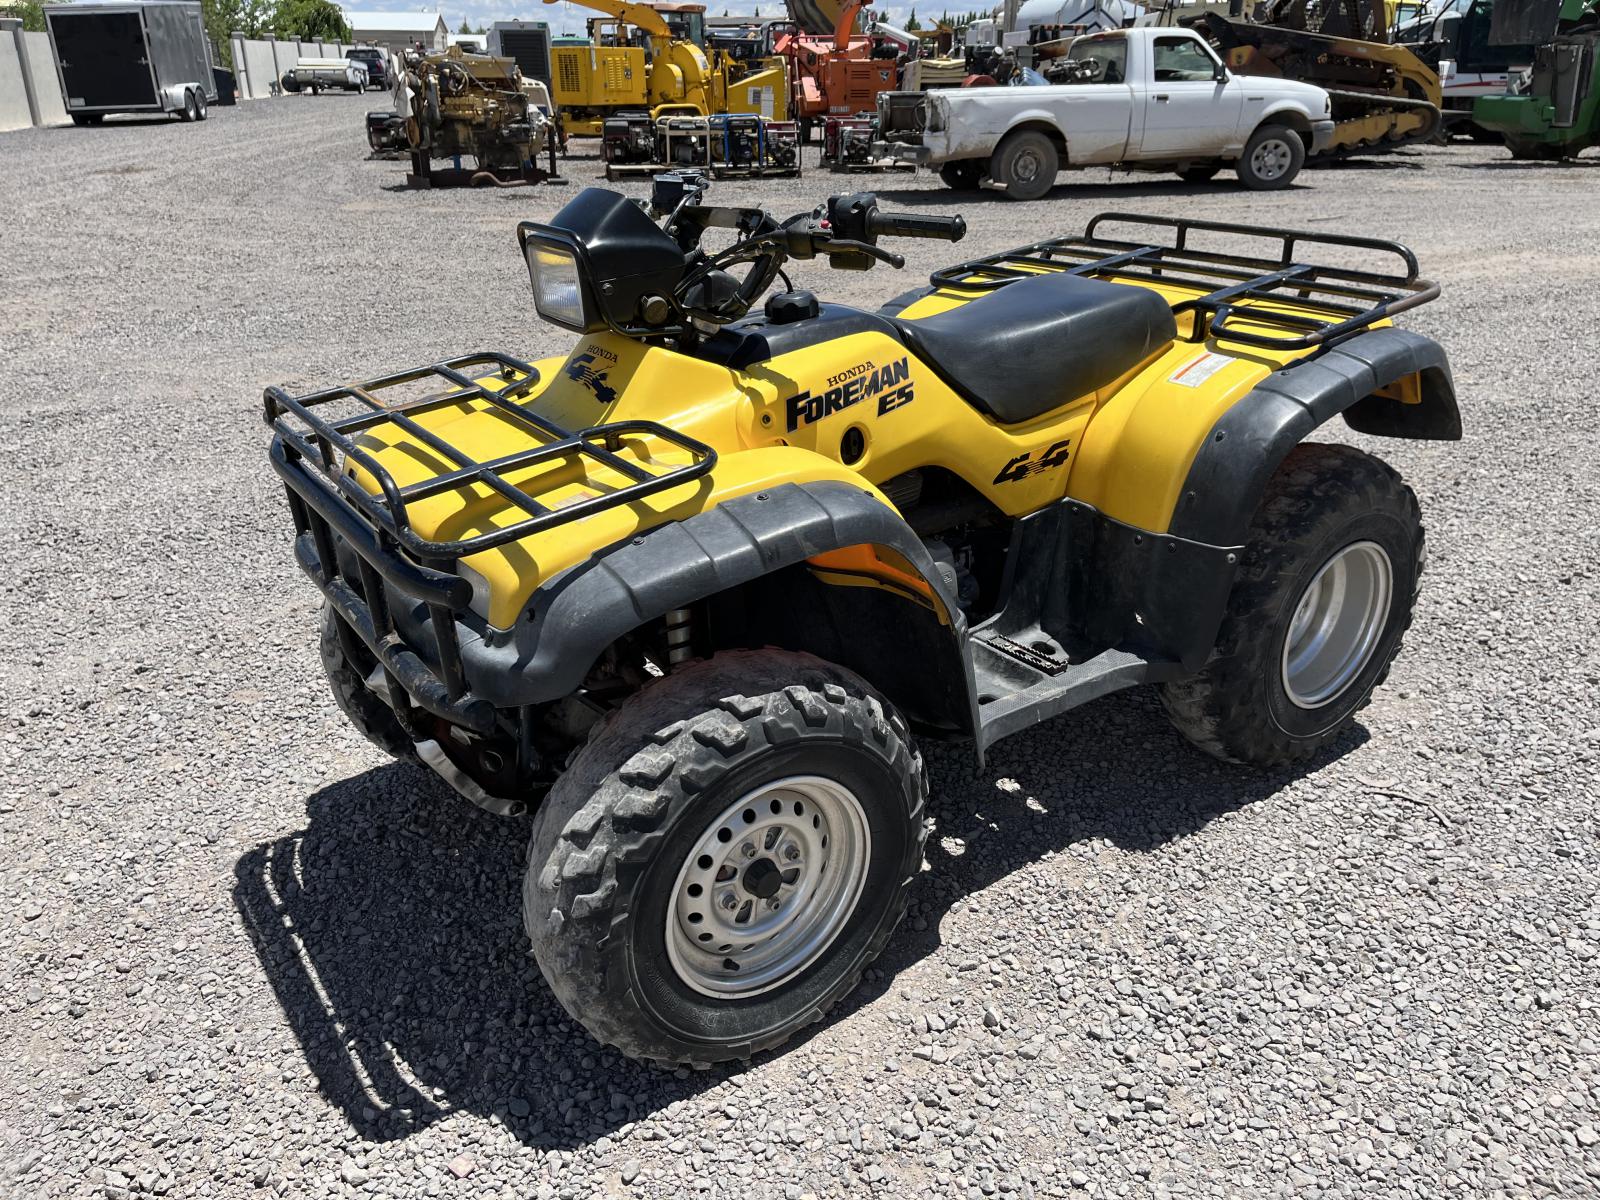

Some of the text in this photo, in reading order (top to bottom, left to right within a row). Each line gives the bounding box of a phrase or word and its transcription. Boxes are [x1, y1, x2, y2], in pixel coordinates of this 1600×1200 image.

[586, 344, 618, 363] HONDA
[826, 360, 876, 387] HONDA
[877, 381, 914, 417] ES
